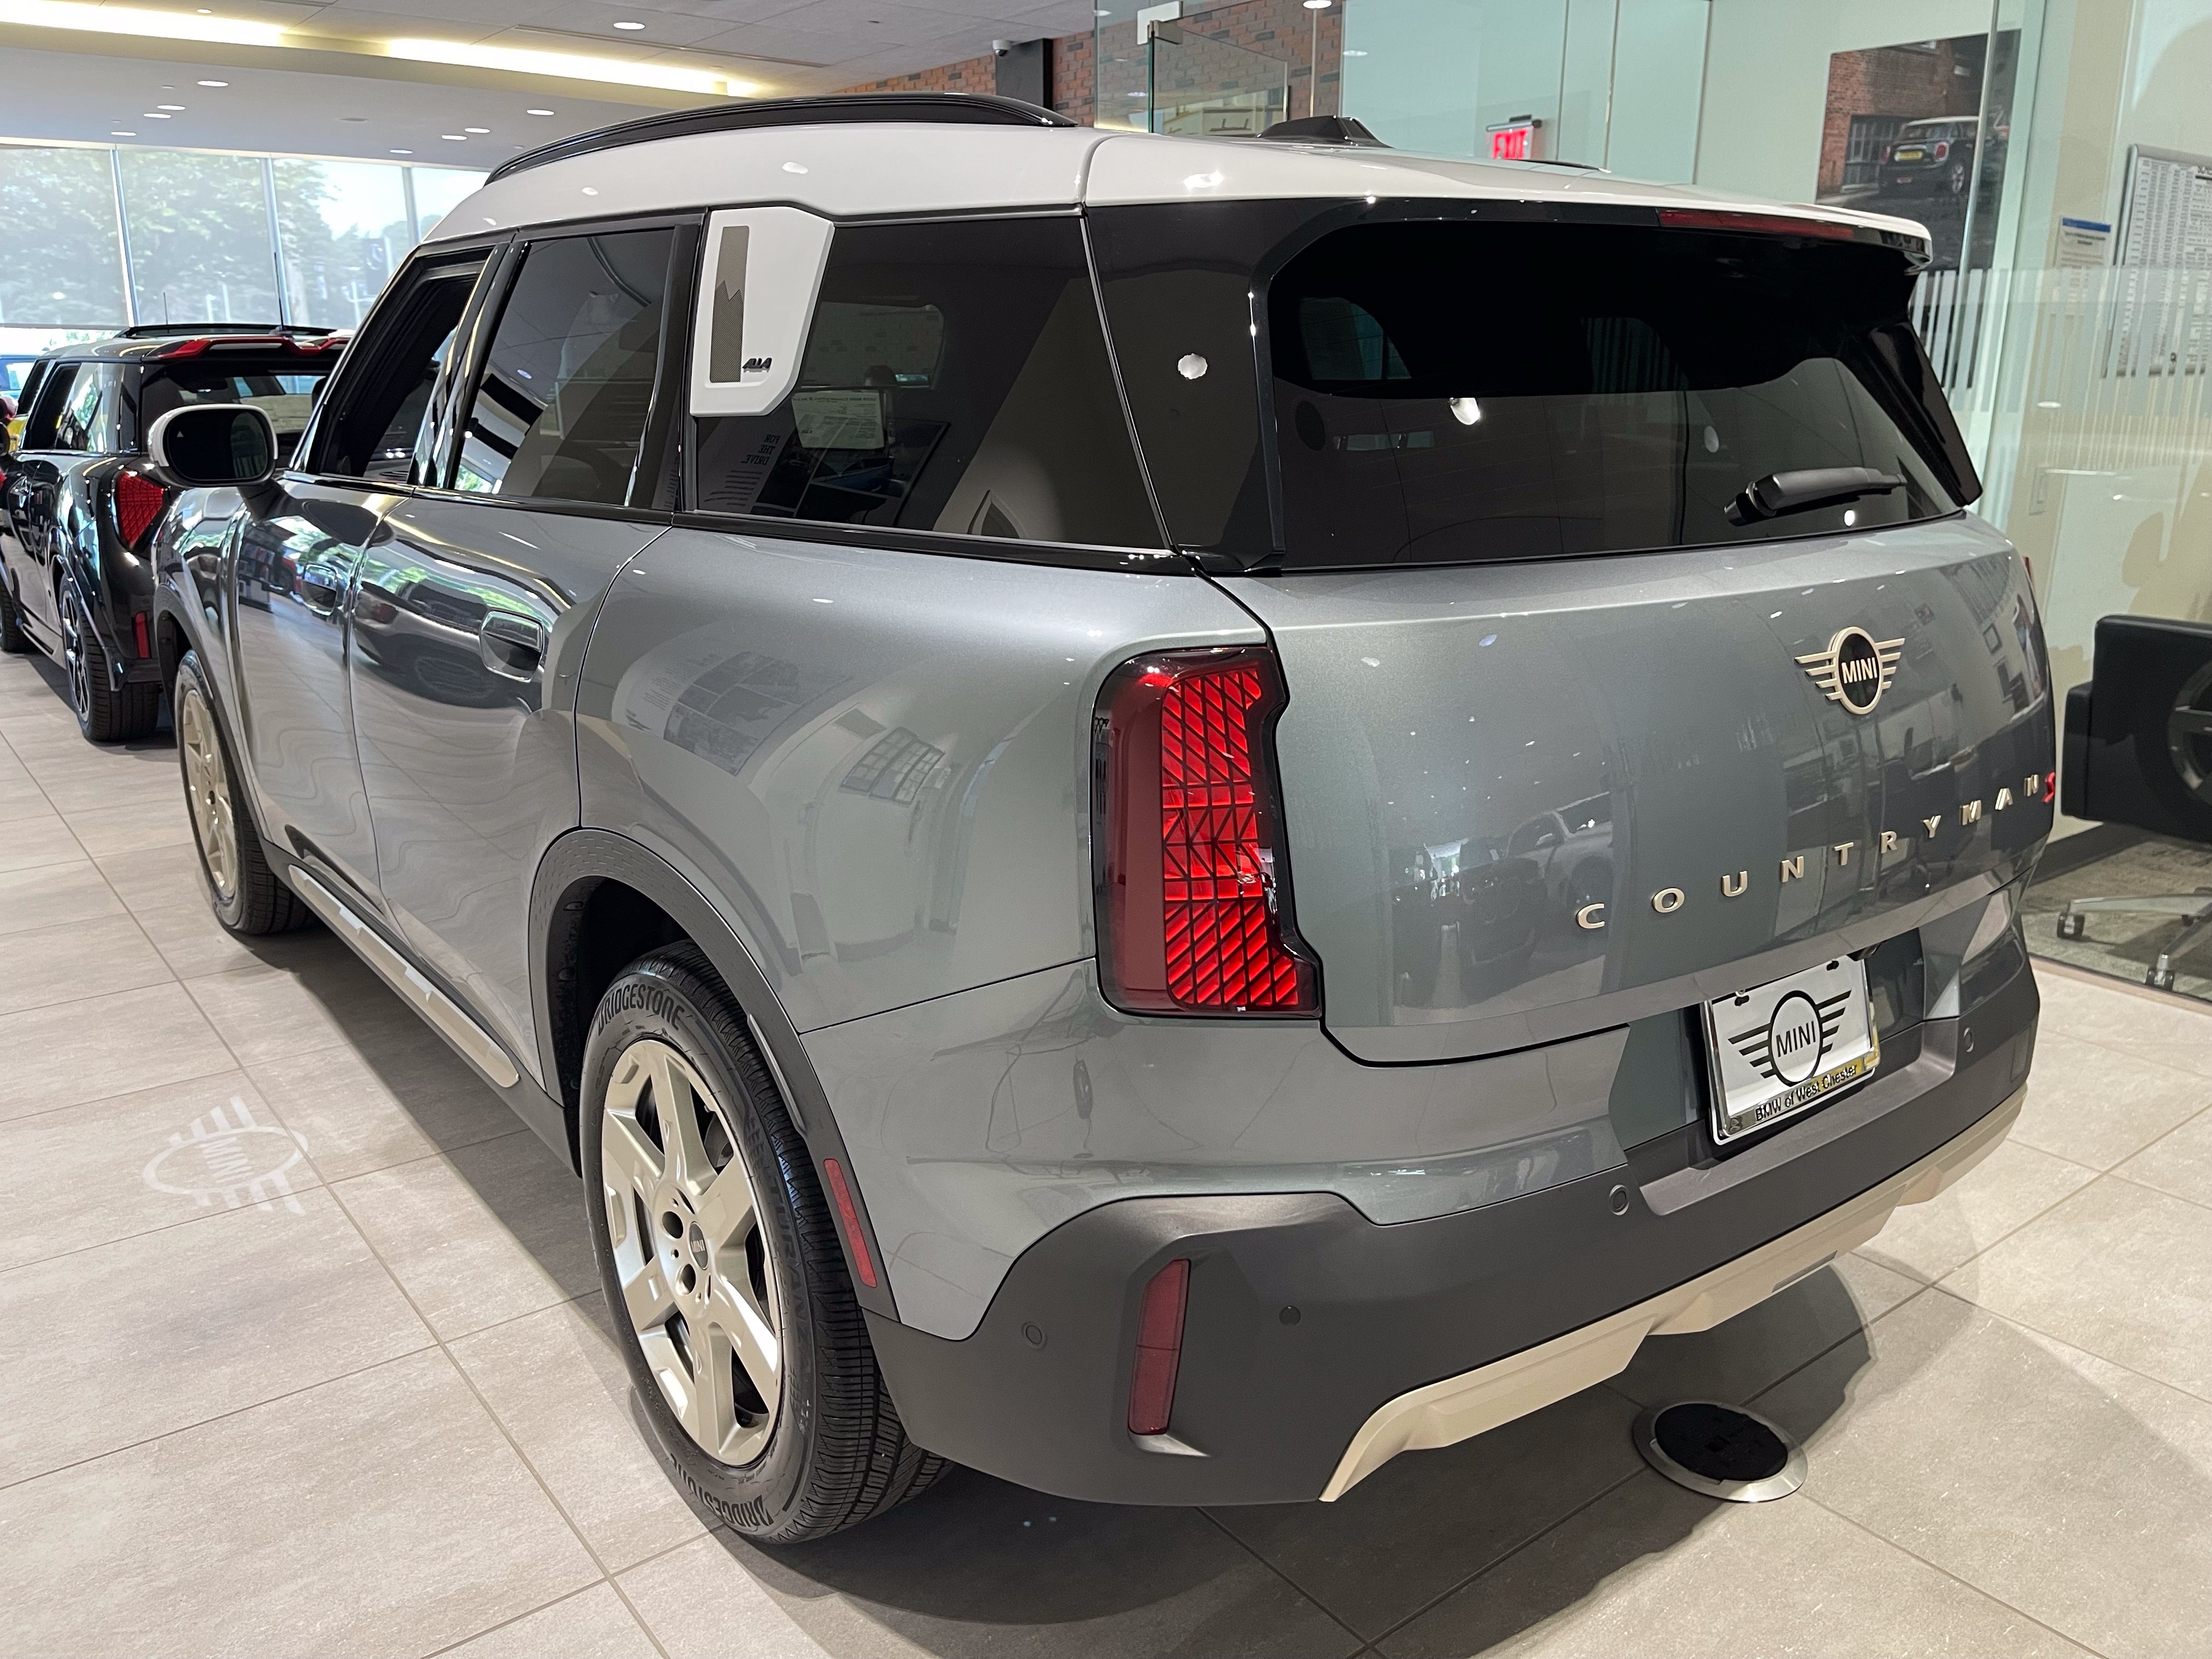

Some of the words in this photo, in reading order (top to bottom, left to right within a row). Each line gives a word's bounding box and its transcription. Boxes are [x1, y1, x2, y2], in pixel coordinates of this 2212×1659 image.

[1493, 129, 1527, 160] EXIT
[1841, 657, 1877, 684] MINI
[1576, 774, 2039, 930] COUNTRYMAN
[597, 984, 685, 1037] BRIDGESTONE
[1776, 1020, 1816, 1058] MINI
[1756, 1098, 1781, 1122] BMW
[1785, 1090, 1796, 1108] of
[1796, 1082, 1821, 1103] West
[1822, 1065, 1857, 1090] Chester
[690, 1239, 706, 1253] MINI
